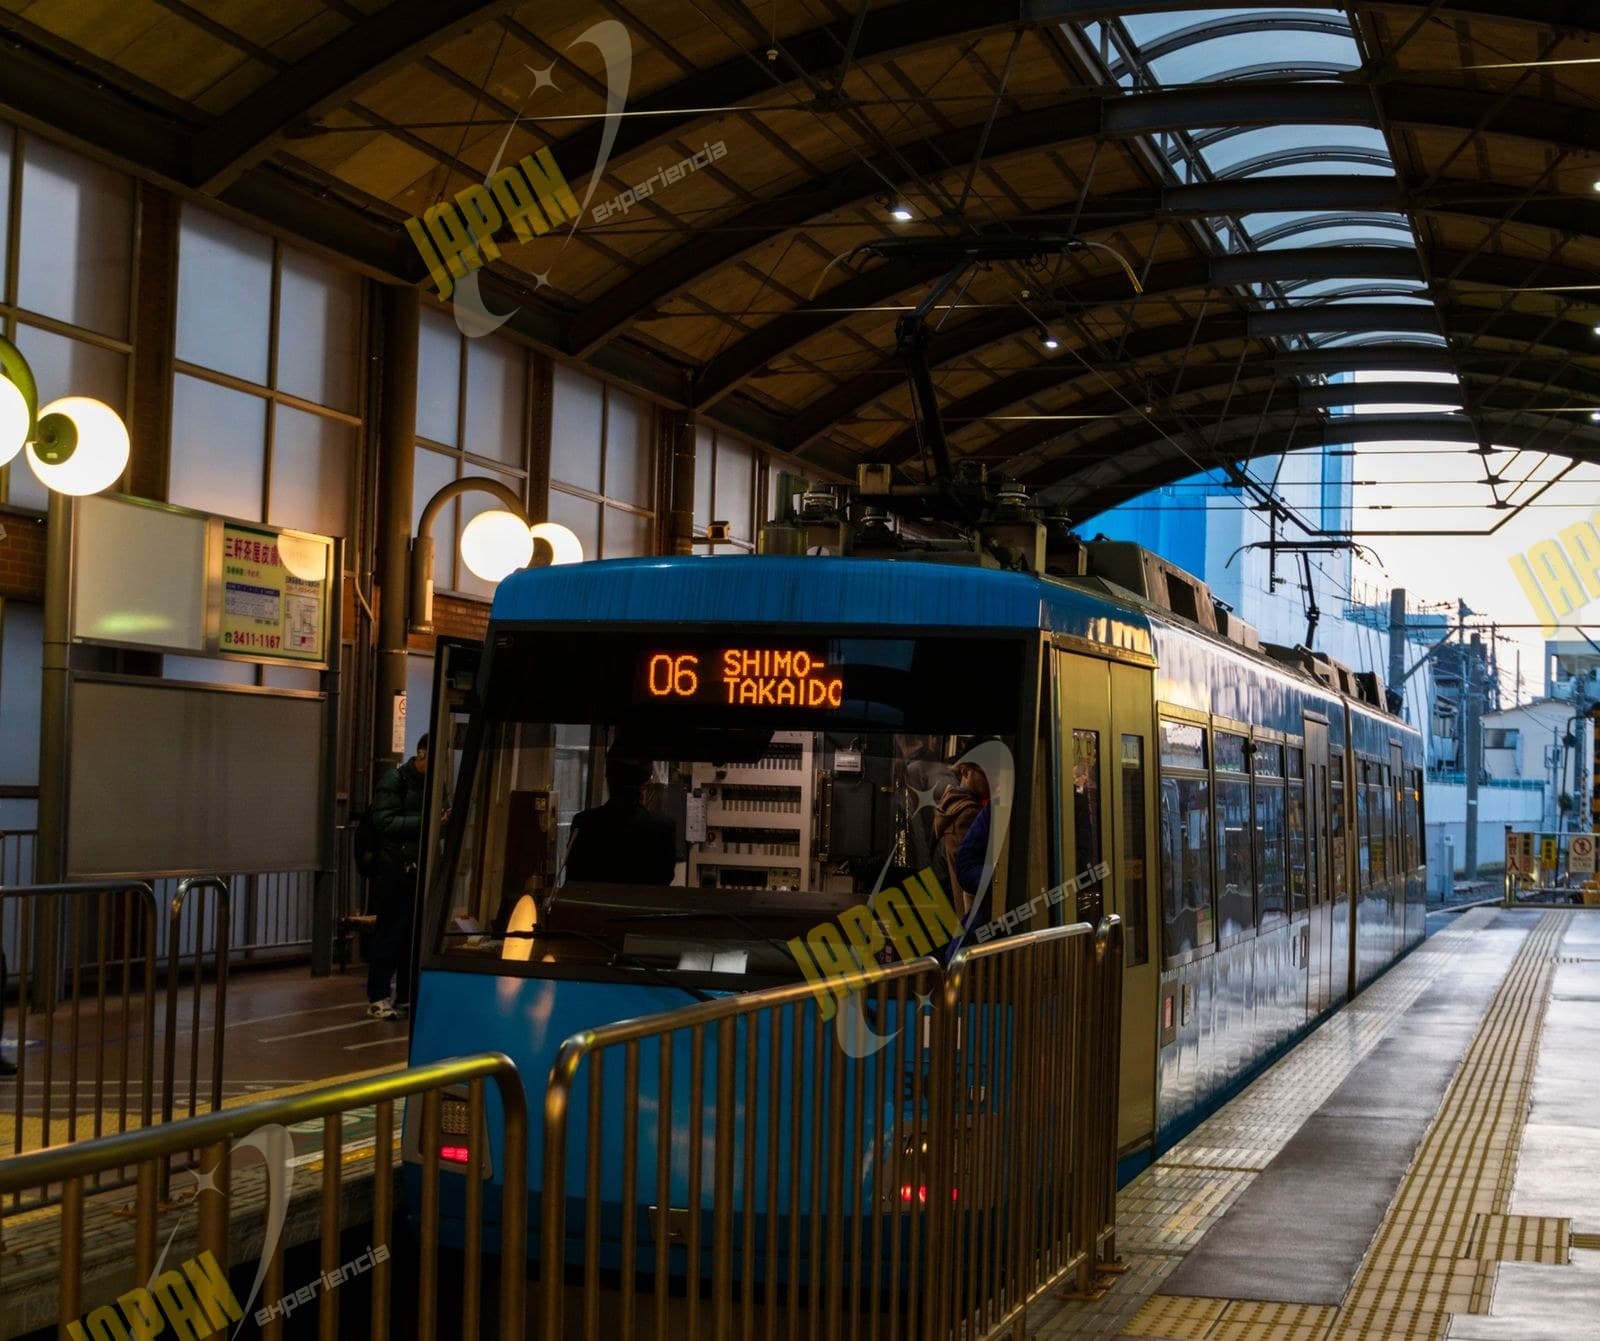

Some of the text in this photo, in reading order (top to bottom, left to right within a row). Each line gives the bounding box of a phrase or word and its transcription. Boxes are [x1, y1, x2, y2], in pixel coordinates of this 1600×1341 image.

[233, 630, 281, 649] 3411-1167
[650, 654, 698, 696] 06
[723, 649, 825, 677] SHIMO-
